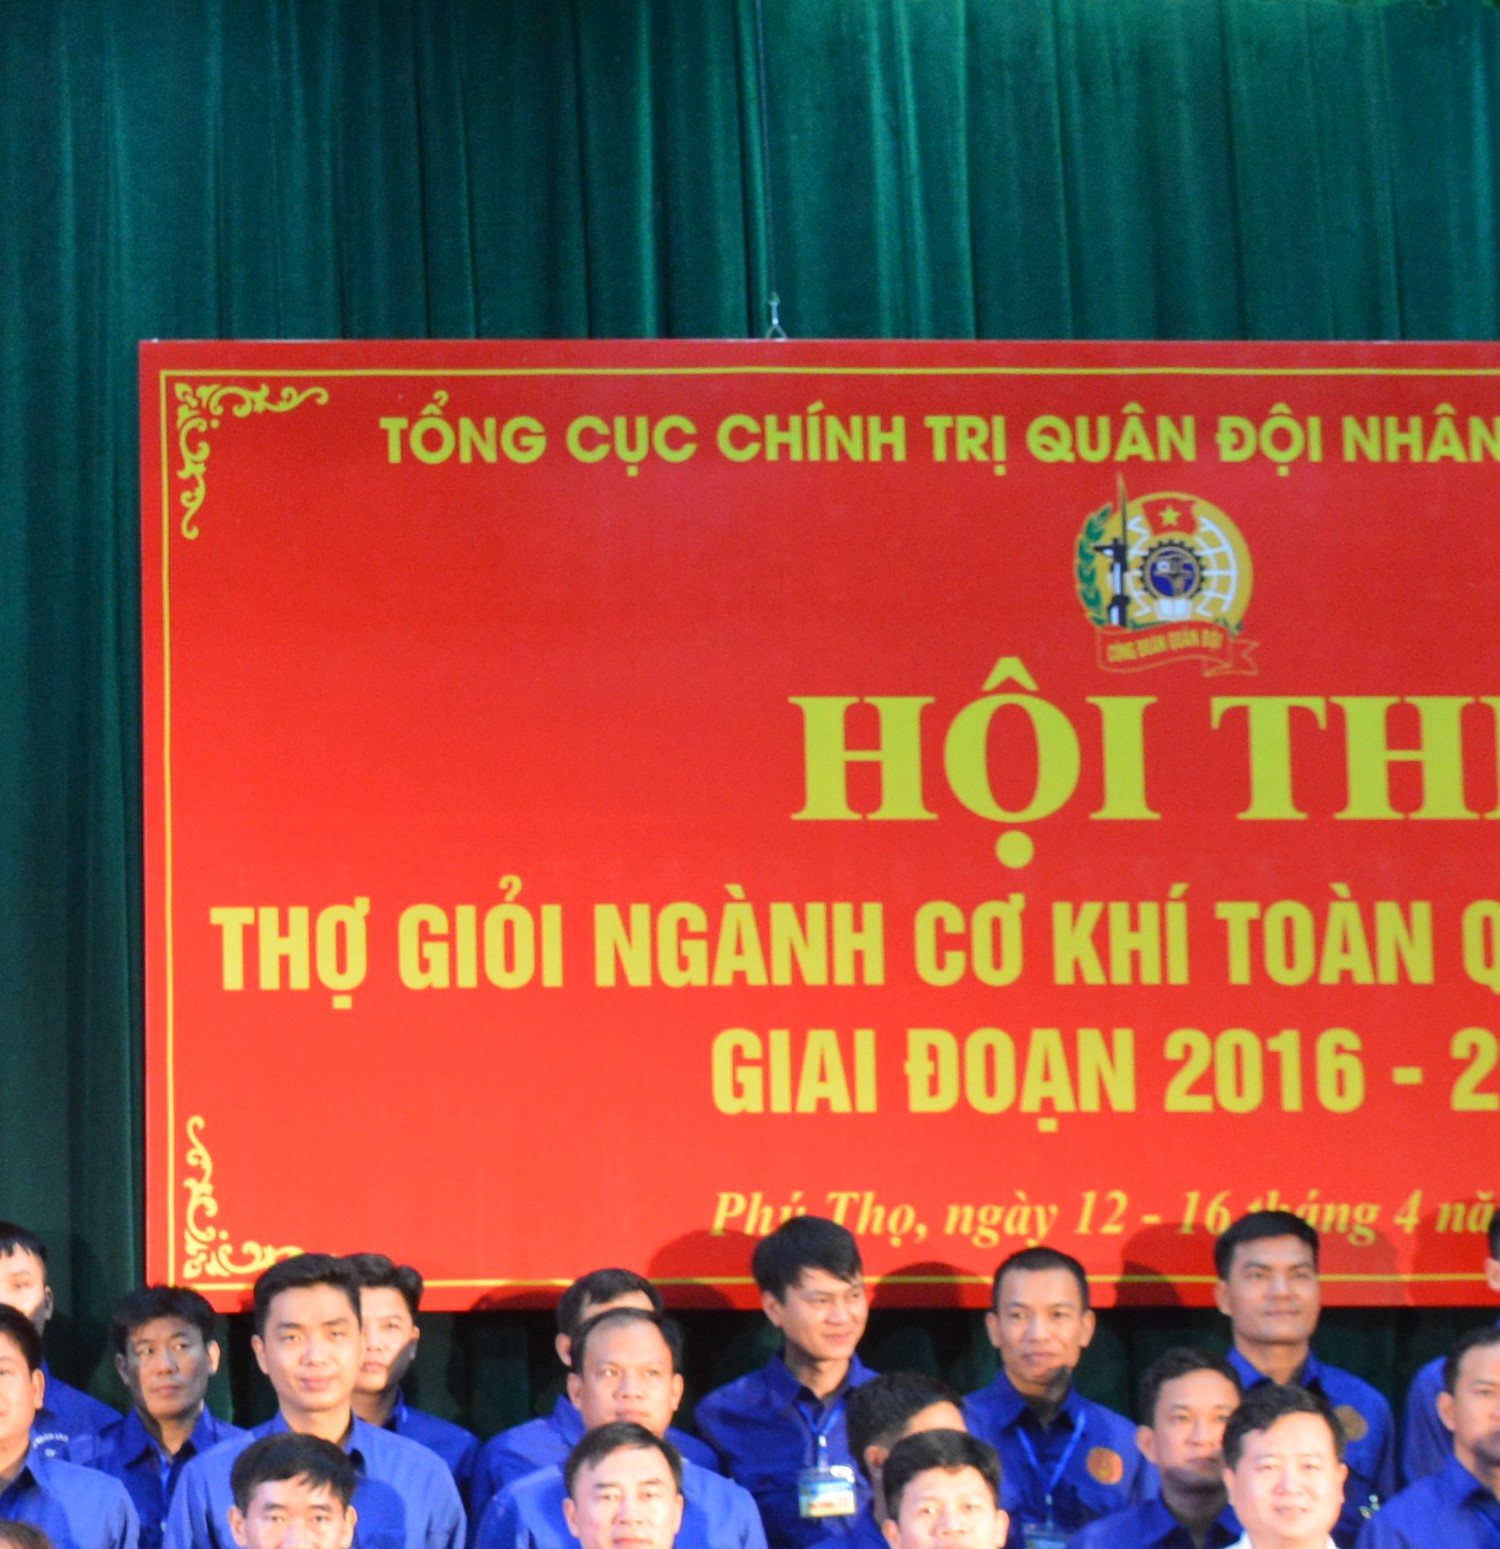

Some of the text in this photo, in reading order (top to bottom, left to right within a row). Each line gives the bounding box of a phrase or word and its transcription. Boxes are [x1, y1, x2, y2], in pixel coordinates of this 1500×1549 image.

[379, 389, 547, 465] TỔNG
[566, 415, 698, 477] CỤC
[716, 400, 907, 462] CHÍNH
[924, 415, 1007, 477] TRỊ
[1026, 401, 1196, 463] QUÂN
[1215, 402, 1322, 478] ĐỘI
[788, 657, 1161, 869] HỘI
[209, 896, 370, 1010] THỢ
[398, 875, 563, 990] GIỎI
[594, 884, 885, 988] NGÀNH
[914, 893, 1025, 986] CƠ
[1052, 882, 1190, 986] KHÍ
[1216, 882, 1433, 985] TOÀN
[712, 1028, 878, 1115] GIAI
[904, 1028, 1136, 1131] ĐOẠN
[1164, 1028, 1364, 1113] 2016
[1394, 1066, 1422, 1084] -
[944, 1190, 1058, 1248] ngày
[1075, 1190, 1128, 1235] 12
[1141, 1213, 1161, 1225] -
[1180, 1190, 1232, 1236] 16
[1394, 1190, 1423, 1233] 4
[1435, 1190, 1494, 1234] nă
